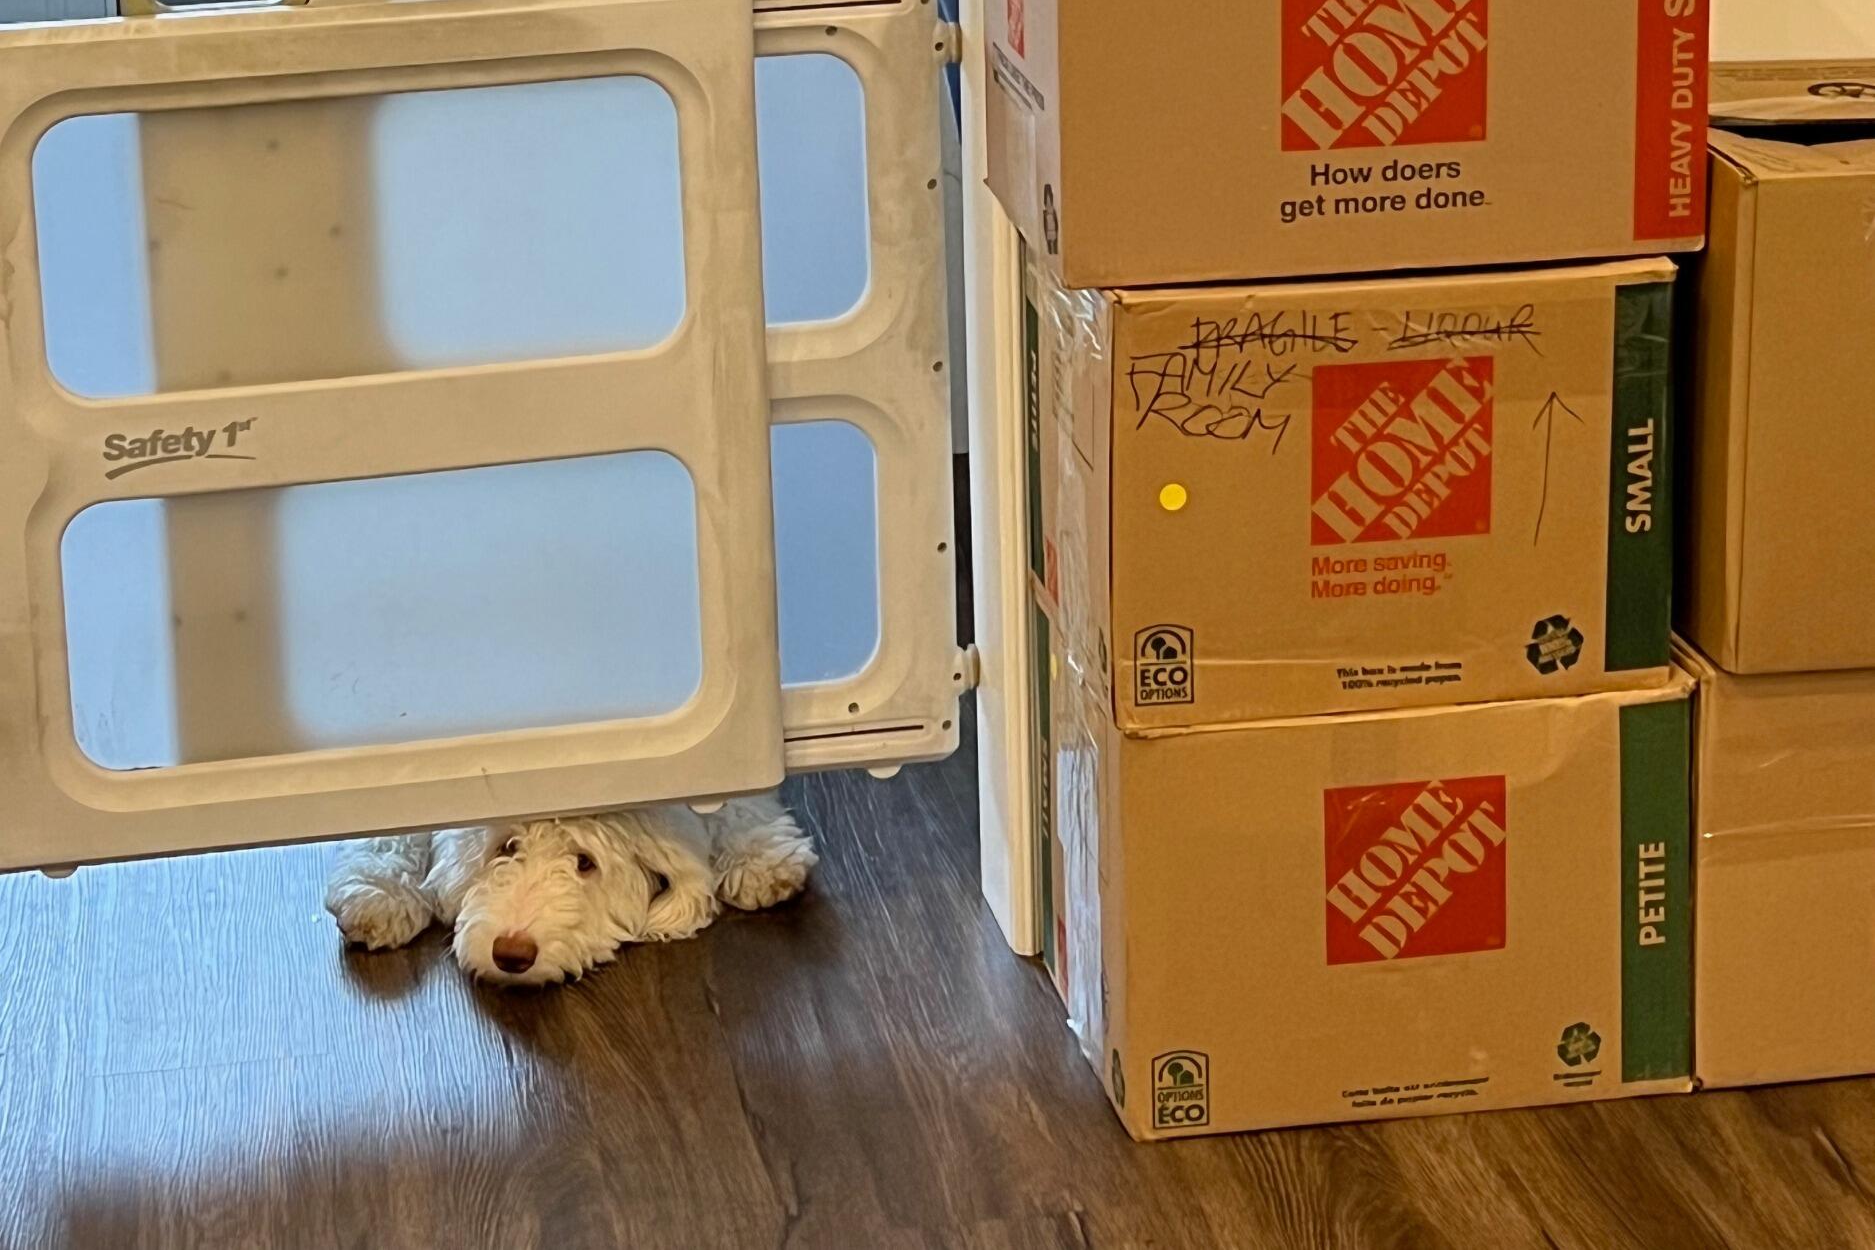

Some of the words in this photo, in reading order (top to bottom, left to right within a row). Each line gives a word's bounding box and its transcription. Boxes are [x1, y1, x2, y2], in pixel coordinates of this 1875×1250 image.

[1361, 12, 1488, 147] DEPOT
[1671, 28, 1696, 109] DUTY
[1310, 163, 1372, 186] How
[1381, 159, 1461, 182] doers
[1668, 120, 1694, 218] HEAVY
[1280, 195, 1326, 223] get
[1335, 194, 1406, 214] more
[1126, 352, 1297, 411] FAMILY
[103, 426, 216, 461] Safety
[1137, 391, 1291, 454] ROOM
[1330, 381, 1405, 454] THE
[1311, 356, 1493, 544] HOME
[1382, 423, 1492, 540] DEPOT
[1625, 418, 1654, 533] SMALL
[1311, 557, 1367, 576] More
[1311, 580, 1367, 598] More
[1140, 667, 1188, 687] ECO
[1140, 687, 1188, 701] OPTIONS
[1326, 780, 1464, 924] HOME
[1359, 801, 1506, 959] DEPOT
[1638, 842, 1666, 946] PETITE
[1157, 1089, 1203, 1103] OPTIONS
[1157, 1104, 1205, 1125] ÉCO
